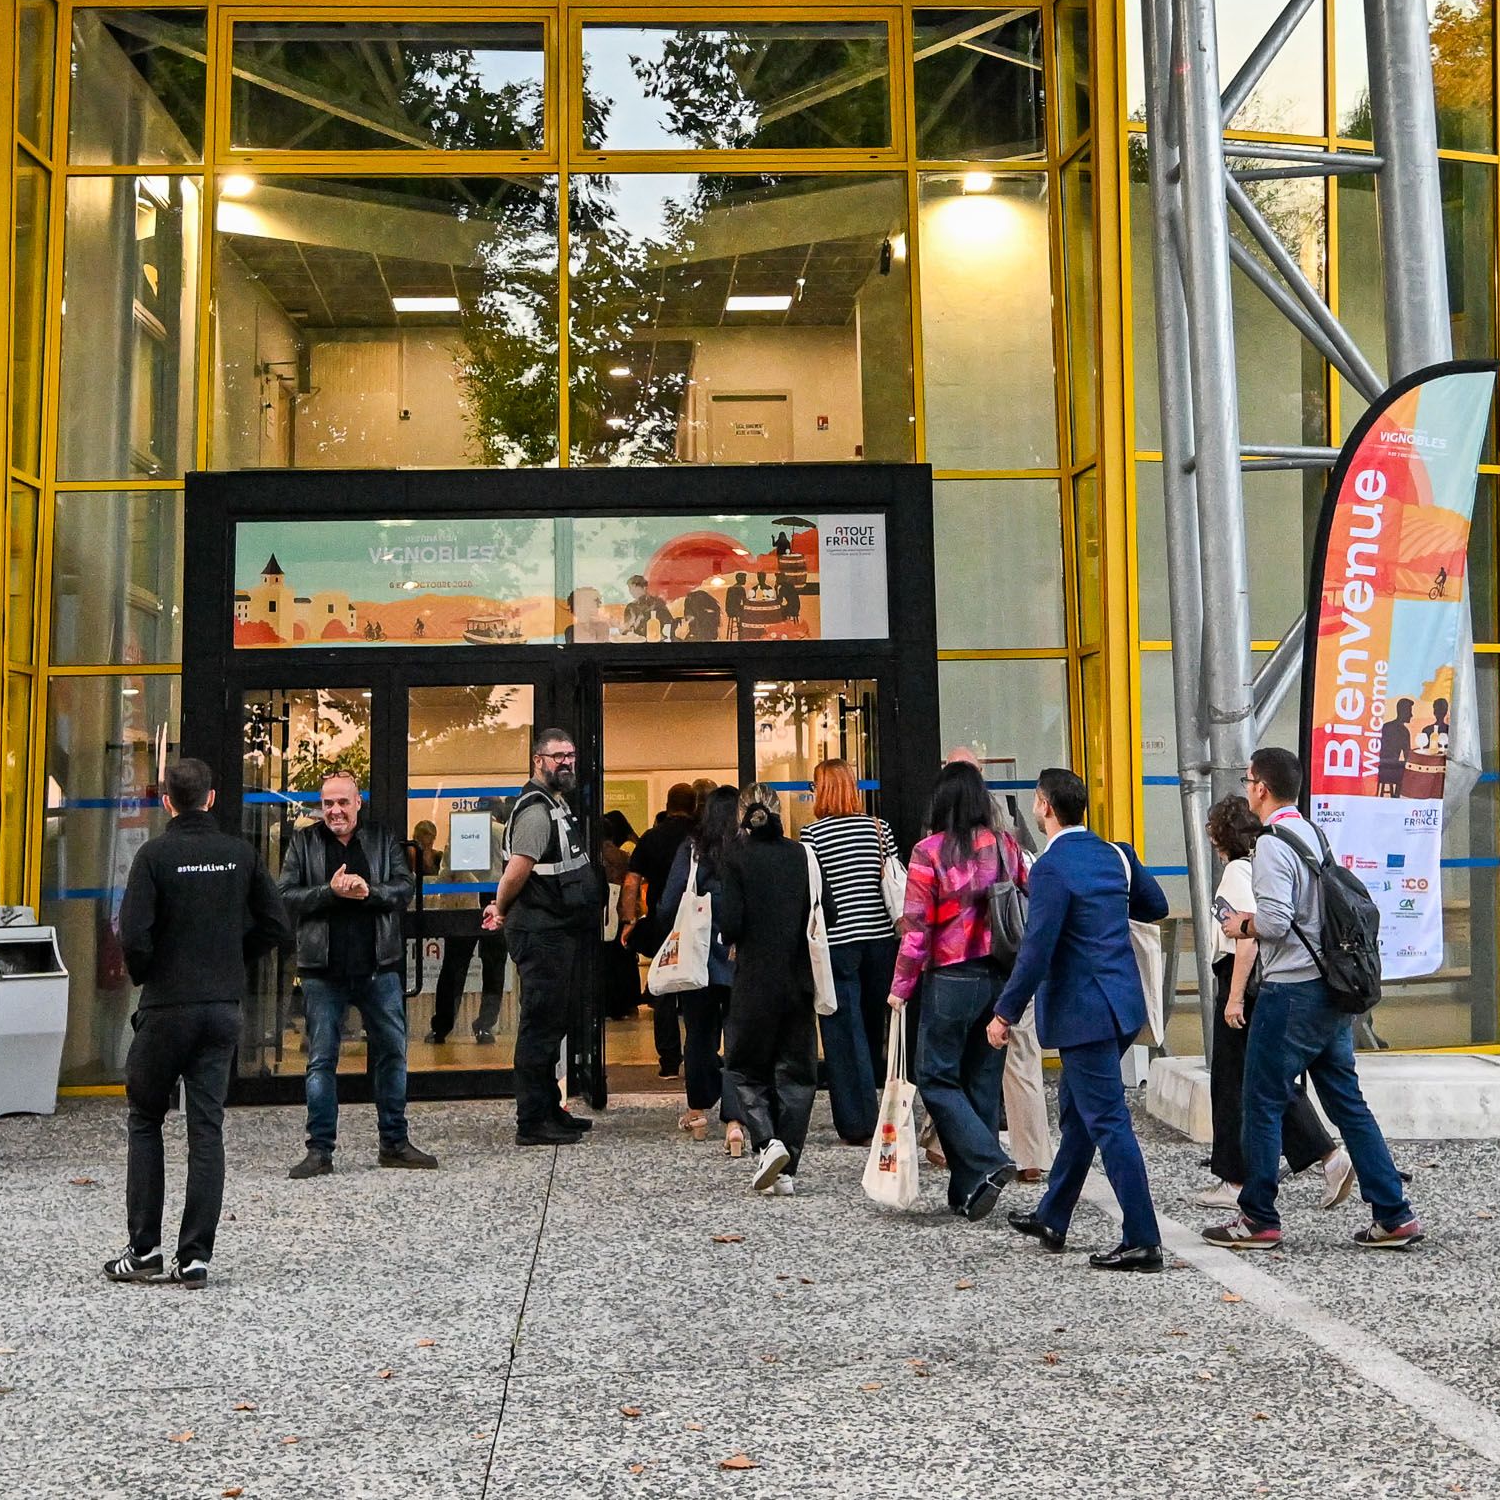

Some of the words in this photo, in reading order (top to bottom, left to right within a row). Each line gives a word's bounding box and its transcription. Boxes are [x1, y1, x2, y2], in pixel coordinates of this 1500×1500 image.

[1380, 431, 1447, 450] VIGNOBLES
[825, 535, 875, 546] FRANCE
[835, 526, 875, 536] ATOUT
[367, 545, 498, 565] VIGNOBLES
[1323, 469, 1387, 778] Bienvenue
[1361, 659, 1389, 778] Welcome
[1404, 817, 1439, 827] FRANCE
